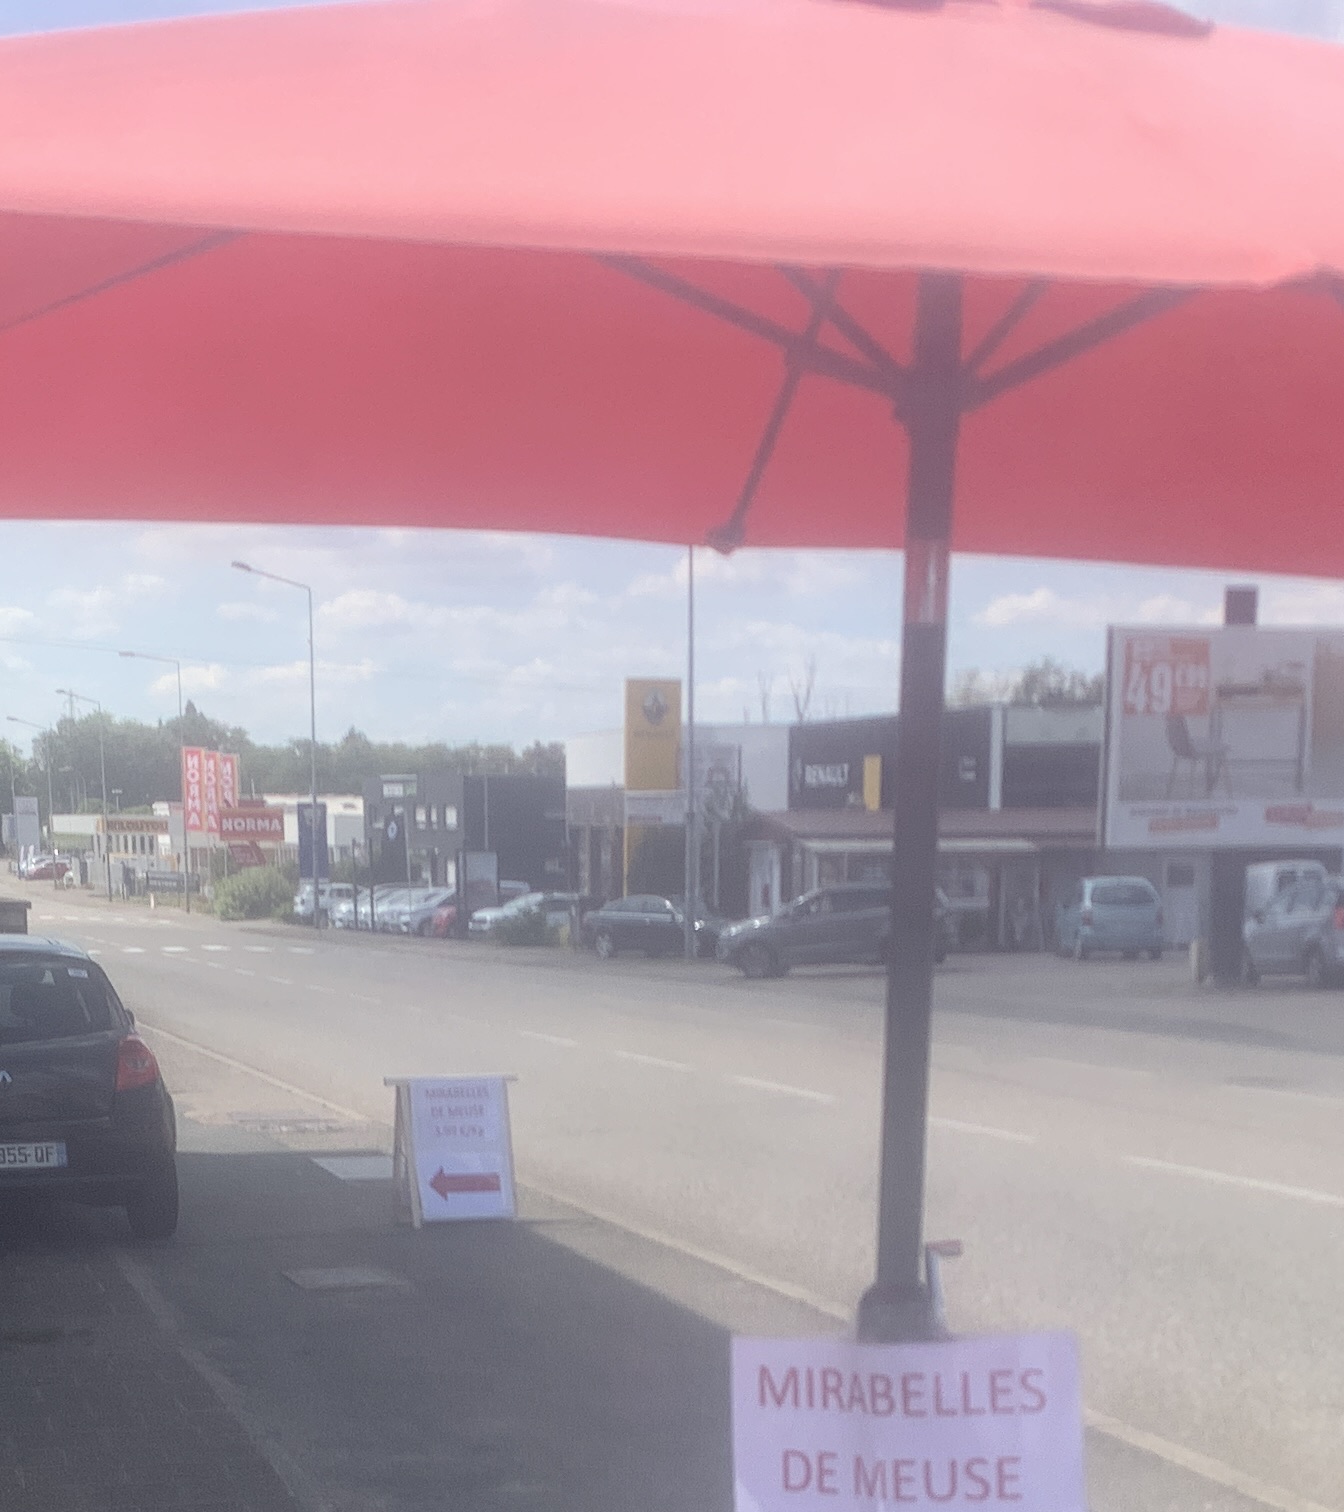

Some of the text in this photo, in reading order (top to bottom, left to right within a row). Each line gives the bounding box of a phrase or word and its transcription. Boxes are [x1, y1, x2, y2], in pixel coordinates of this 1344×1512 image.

[222, 818, 282, 831] NORMA
[757, 1364, 1048, 1418] MIRABELLES
[781, 1448, 1023, 1503] DE MEUSE
